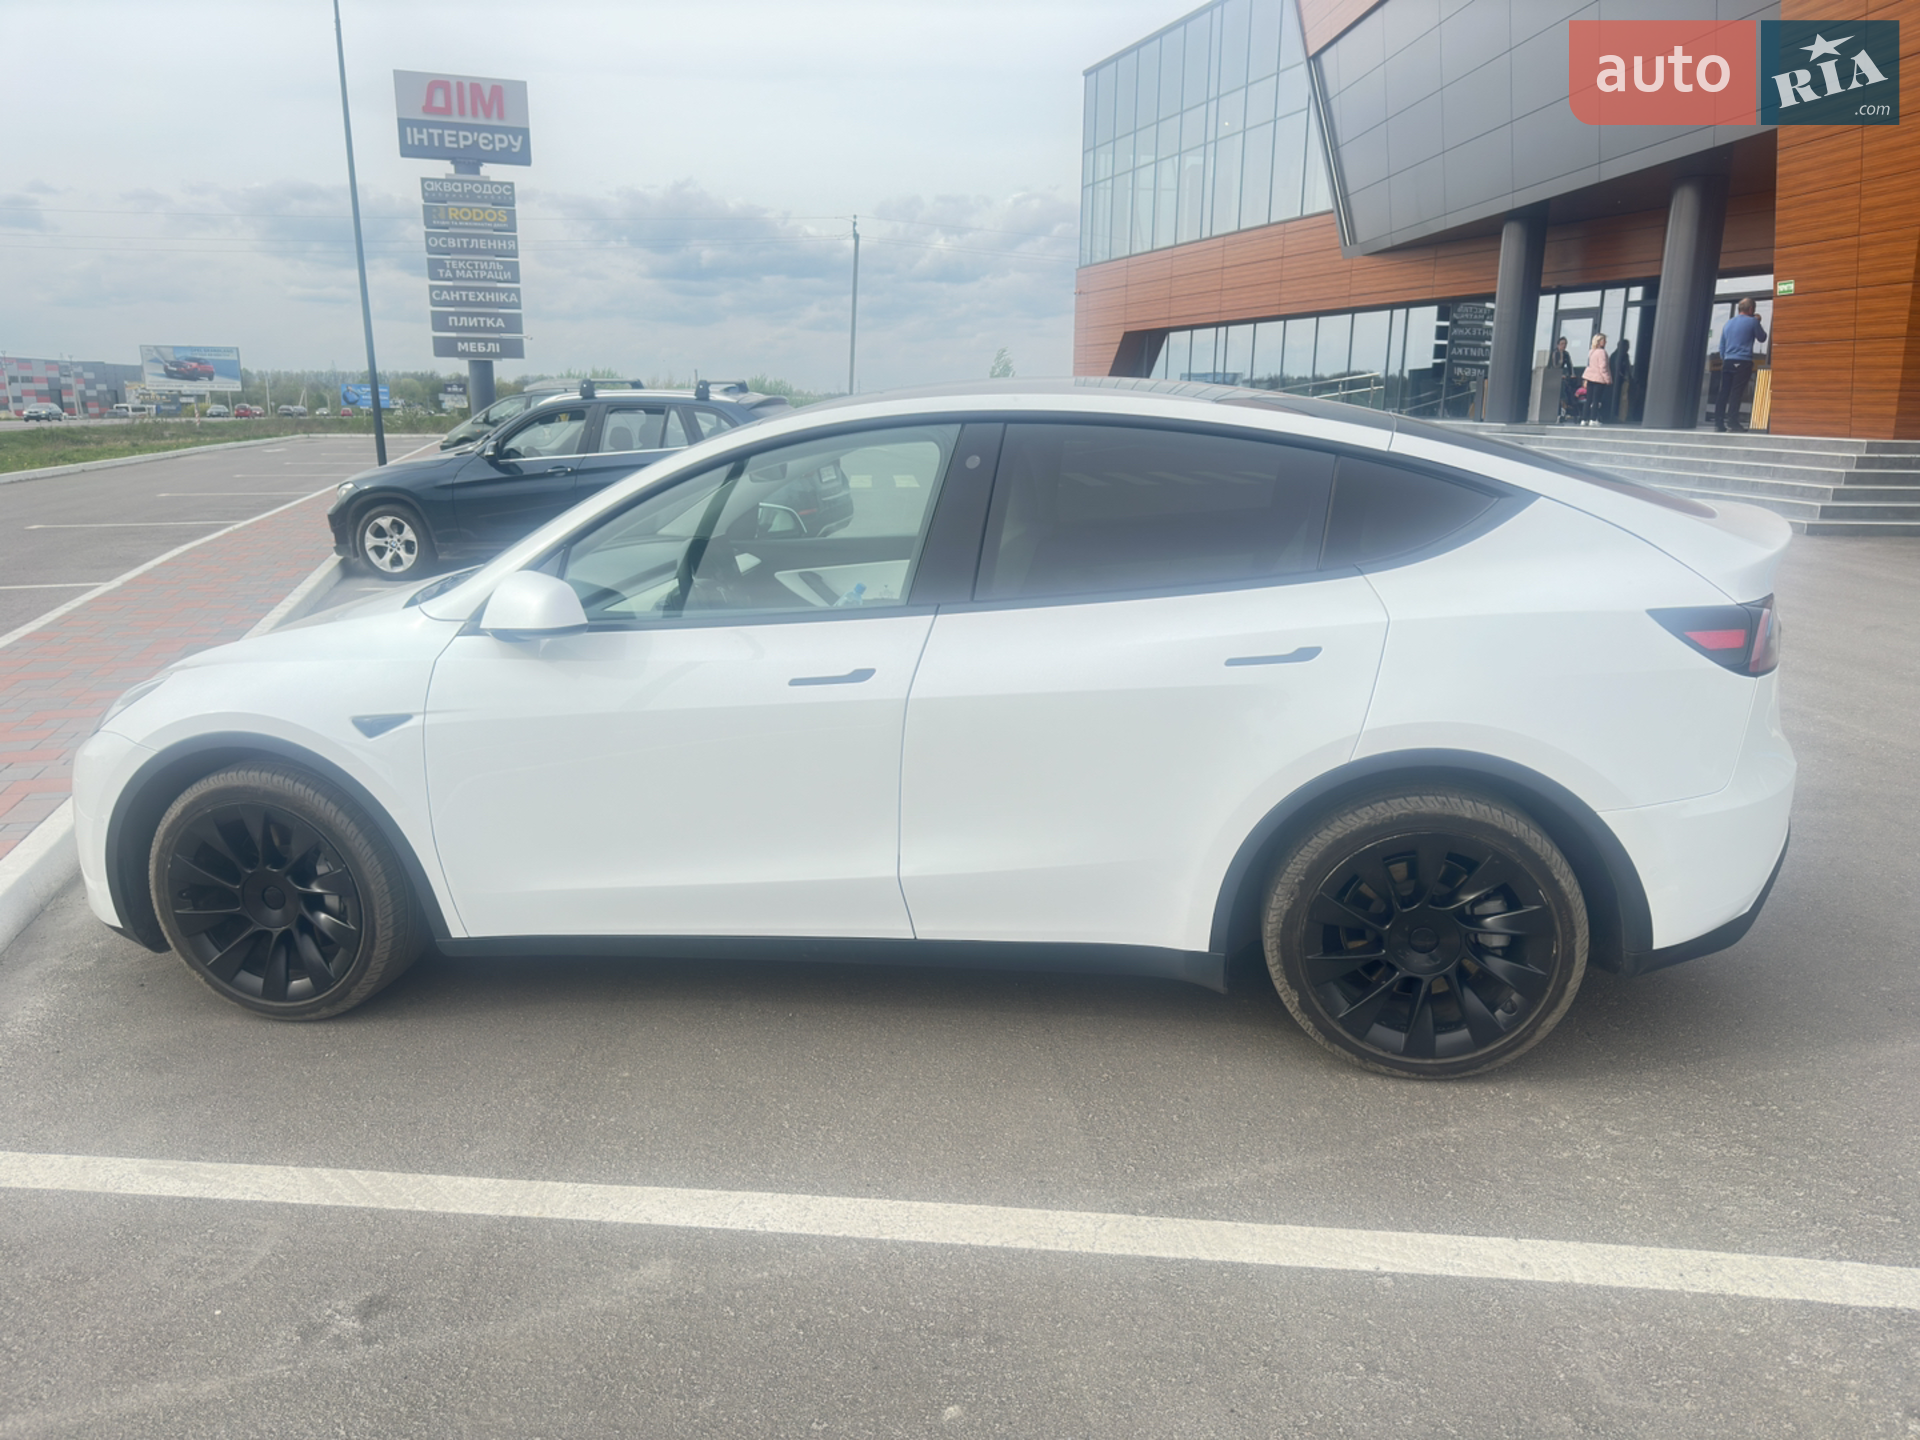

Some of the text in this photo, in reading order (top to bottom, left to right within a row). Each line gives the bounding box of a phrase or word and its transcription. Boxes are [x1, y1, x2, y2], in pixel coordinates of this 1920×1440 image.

[421, 79, 505, 120] ДІМ
[406, 126, 523, 153] ІНТЕР'ЄРУ
[448, 207, 507, 222] RODOS
[428, 236, 516, 250] ОСВІТЛЕННЯ
[444, 260, 504, 271] ТЕКСТИЛЬ
[437, 269, 512, 280] ТА МАТРАЦИ
[431, 290, 519, 303] САНТЕХНІКА
[448, 315, 506, 328] ПЛИТКА
[457, 341, 500, 353] МЕБЛІ
